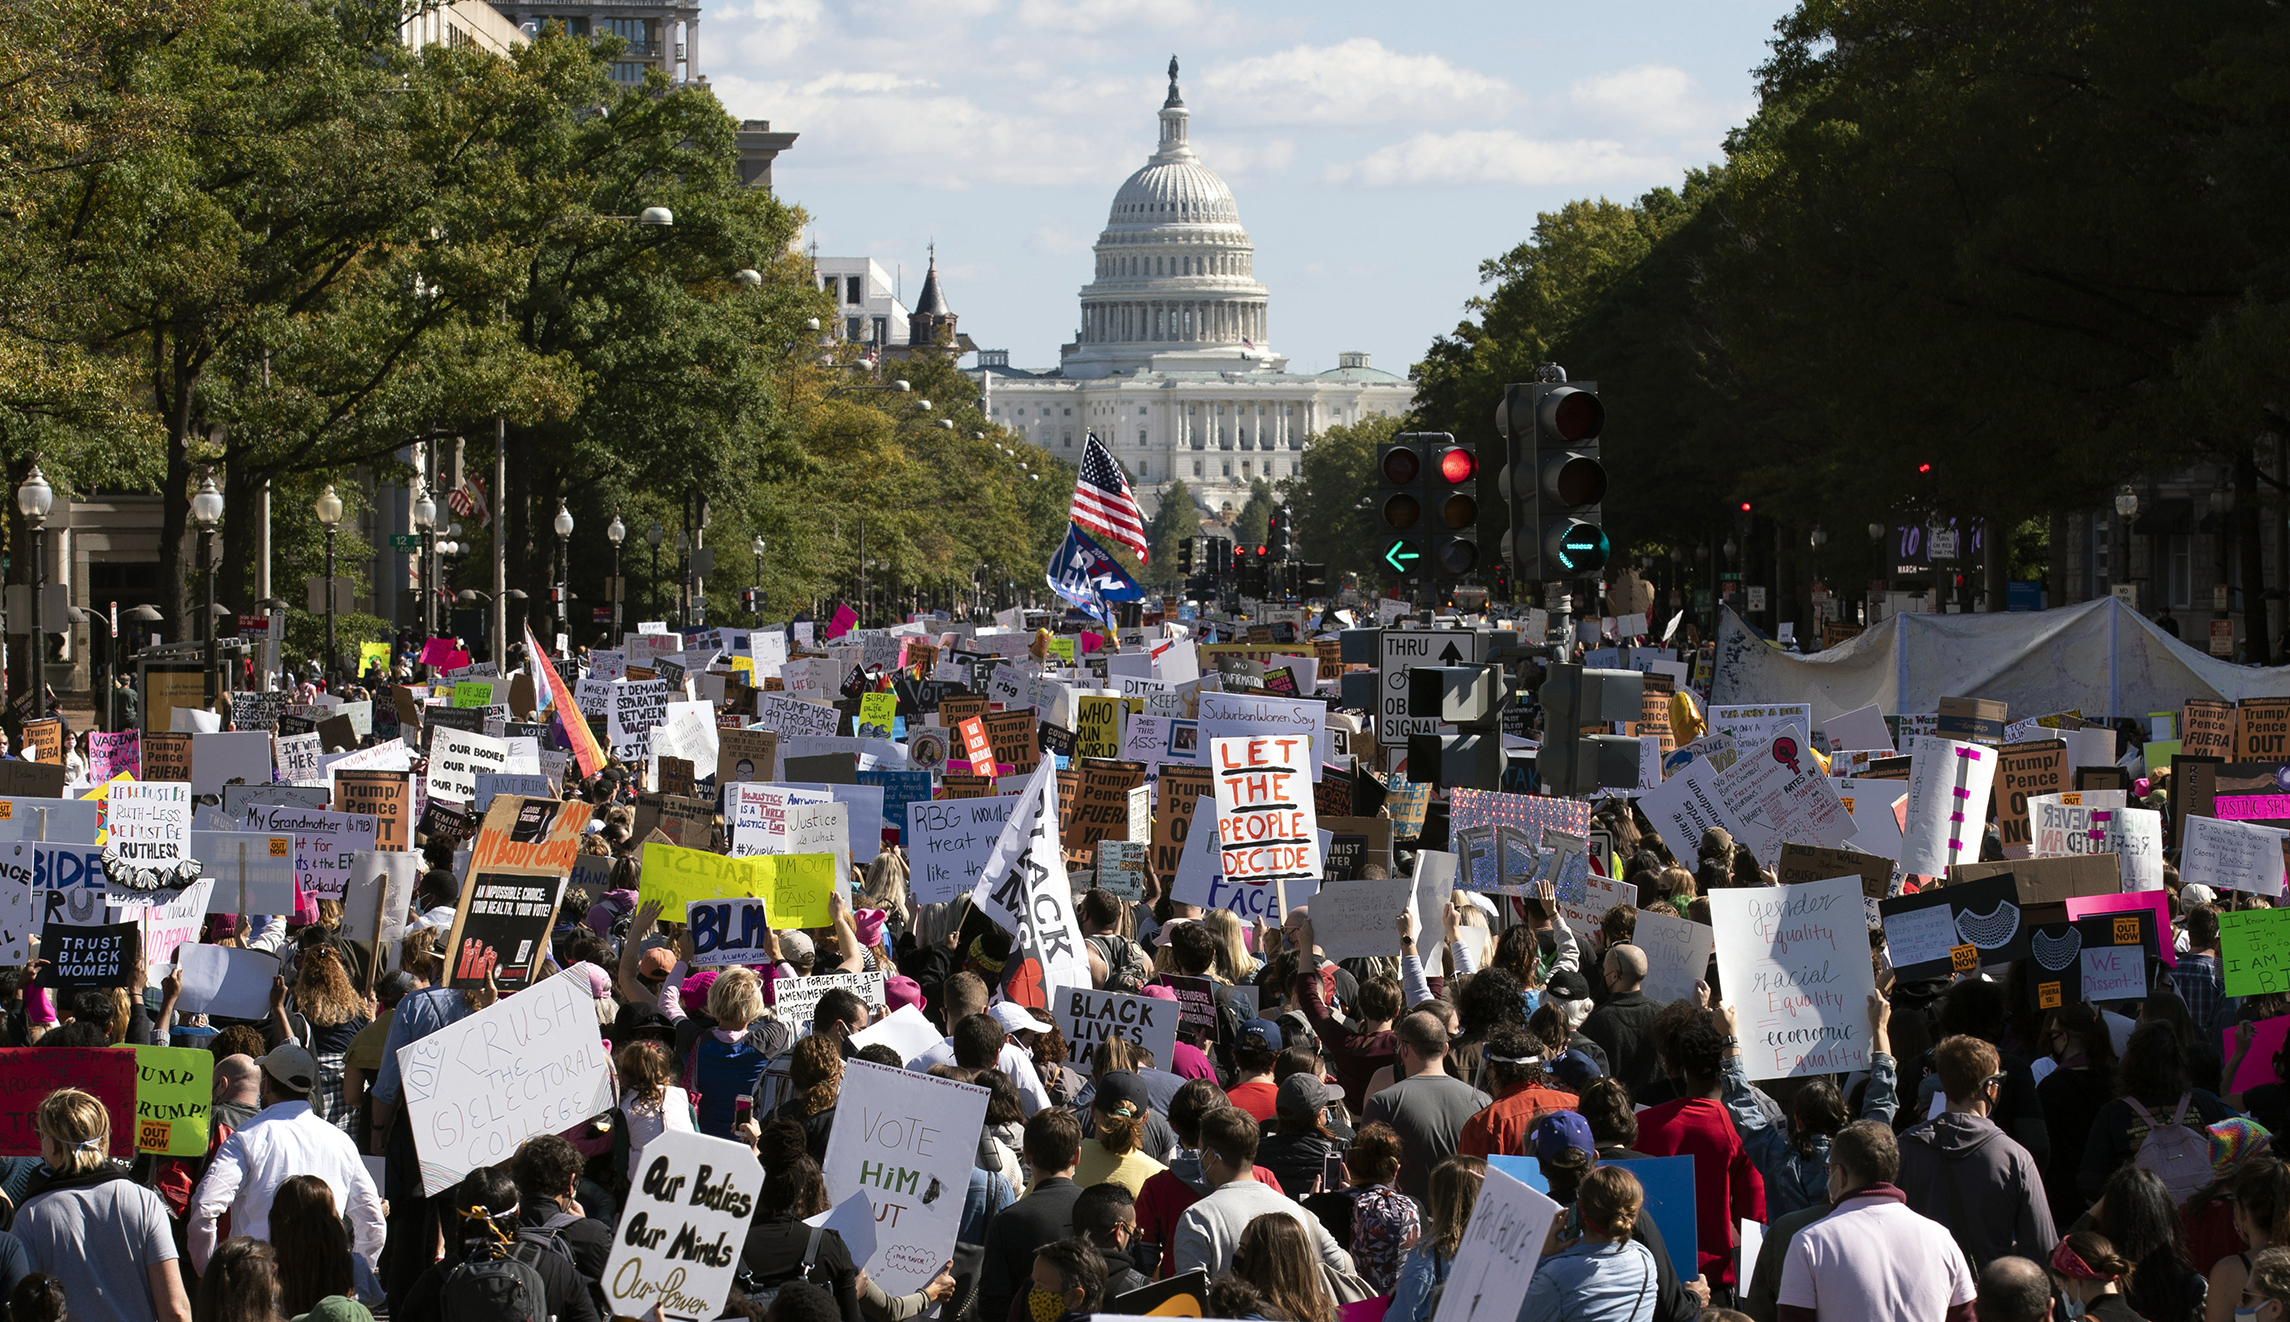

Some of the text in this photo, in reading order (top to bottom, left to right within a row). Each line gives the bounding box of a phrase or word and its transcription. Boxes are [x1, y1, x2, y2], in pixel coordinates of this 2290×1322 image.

[1897, 565, 1917, 574] MARCH
[1387, 638, 1428, 655] THRU
[1233, 662, 1248, 670] NO
[583, 684, 609, 694] WHEN
[618, 682, 668, 696] I DEMAND
[995, 681, 1019, 697] rbg
[580, 696, 608, 707] THERE
[616, 694, 668, 709] SEPARATION
[865, 694, 888, 703] SURF
[1149, 693, 1178, 708] KEEP
[618, 706, 667, 722] BETWEEN
[768, 697, 834, 719] TRUMP HAS
[943, 702, 985, 714] Trump/
[1079, 702, 1113, 724] WHO
[2188, 708, 2230, 721] Trump/
[286, 718, 308, 728] COUNT
[765, 710, 837, 733] 99 PROBLEMS
[987, 718, 1031, 735] Trump/
[1135, 718, 1156, 727] DOES
[1292, 707, 1315, 731] Say
[2189, 719, 2226, 731] Pence
[26, 726, 58, 738] Trump/
[286, 724, 295, 732] ON
[520, 726, 547, 737] VOTE
[1076, 726, 1101, 741] RUN
[1136, 727, 1155, 736] THIS
[2247, 722, 2287, 734] Pence
[27, 736, 56, 747] Pence
[991, 731, 1030, 745] Pence
[1046, 736, 1069, 749] ON US
[1127, 735, 1158, 749] ASS
[2183, 732, 2230, 747] ¡FUERA
[2248, 734, 2286, 753] OUT
[144, 741, 187, 753] Trump/
[448, 743, 505, 763] OUR BODIES
[994, 745, 1030, 763] OUT
[1221, 739, 1298, 768] LET
[1703, 739, 1723, 754] LAKE
[1998, 741, 2059, 753] RefuseFascism.org
[147, 752, 183, 764] Pence
[288, 753, 316, 768] HER
[1998, 751, 2060, 772] Trump/
[143, 765, 188, 781] ¡FUERA
[442, 760, 465, 773] OUR
[341, 770, 402, 781] RefuseFascism.org
[1083, 769, 1138, 787] Trump/
[1782, 766, 1817, 795] RATES IN
[2005, 772, 2059, 790] Pence
[111, 785, 187, 801] IF MUST BE
[340, 781, 402, 800] Trump/
[430, 779, 453, 792] OUR
[1223, 774, 1291, 806] THE
[1718, 782, 1737, 798] BIRTH
[344, 799, 398, 815] Pence
[2064, 796, 2081, 805] OUT
[2213, 799, 2262, 816] CASTING
[555, 801, 592, 833] MY
[739, 805, 756, 816] IS A
[913, 804, 962, 832] RBG
[246, 809, 342, 831] My Grandmother
[736, 819, 767, 830] JUSTICE
[789, 808, 838, 831] Justice
[1219, 812, 1309, 842] PEOPLE
[109, 823, 183, 839] WE MUST BE
[119, 840, 180, 860] RUTHLESS.
[492, 833, 537, 869] BODY
[926, 834, 978, 854] treat
[319, 859, 335, 869] the
[1222, 846, 1310, 875] DECIDE
[1835, 847, 1864, 865] WALL
[775, 855, 834, 875] HIM OUT
[926, 862, 951, 882] like
[775, 877, 797, 889] ALL
[474, 884, 524, 900] AN IMPOSSIBLE
[1206, 874, 1280, 918] FACE
[470, 900, 553, 917] YOUR HEALTH, YOUR VOTE!
[692, 903, 767, 954] BLM
[2117, 924, 2138, 934] OUT
[2223, 914, 2241, 928] I
[61, 935, 122, 950] TRUST
[1763, 923, 1837, 955] Equality
[2115, 933, 2139, 942] NOW
[58, 950, 120, 964] BLACK
[694, 951, 768, 963] LOVE ALWAYS WINS
[1955, 949, 1974, 960] OUT
[1955, 957, 1977, 968] NOW
[2089, 951, 2122, 971] WE
[2228, 953, 2278, 972] I AM
[57, 963, 120, 978] WOMEN
[855, 984, 873, 994] THE
[1069, 991, 1154, 1028] BLACK
[1767, 990, 1844, 1017] Equality
[456, 985, 577, 1075] CRUSH
[1759, 1022, 1862, 1046] economic
[1773, 1046, 1863, 1075] Equality
[485, 1057, 529, 1089] THE
[143, 1127, 166, 1137] OUT
[467, 1090, 591, 1166] COLLEGE
[863, 1106, 942, 1157] VOTE
[140, 1137, 170, 1148] NOW
[642, 1154, 753, 1219] Our Bodies
[624, 1210, 734, 1269] Our Minds
[612, 1256, 714, 1315] Our Power
